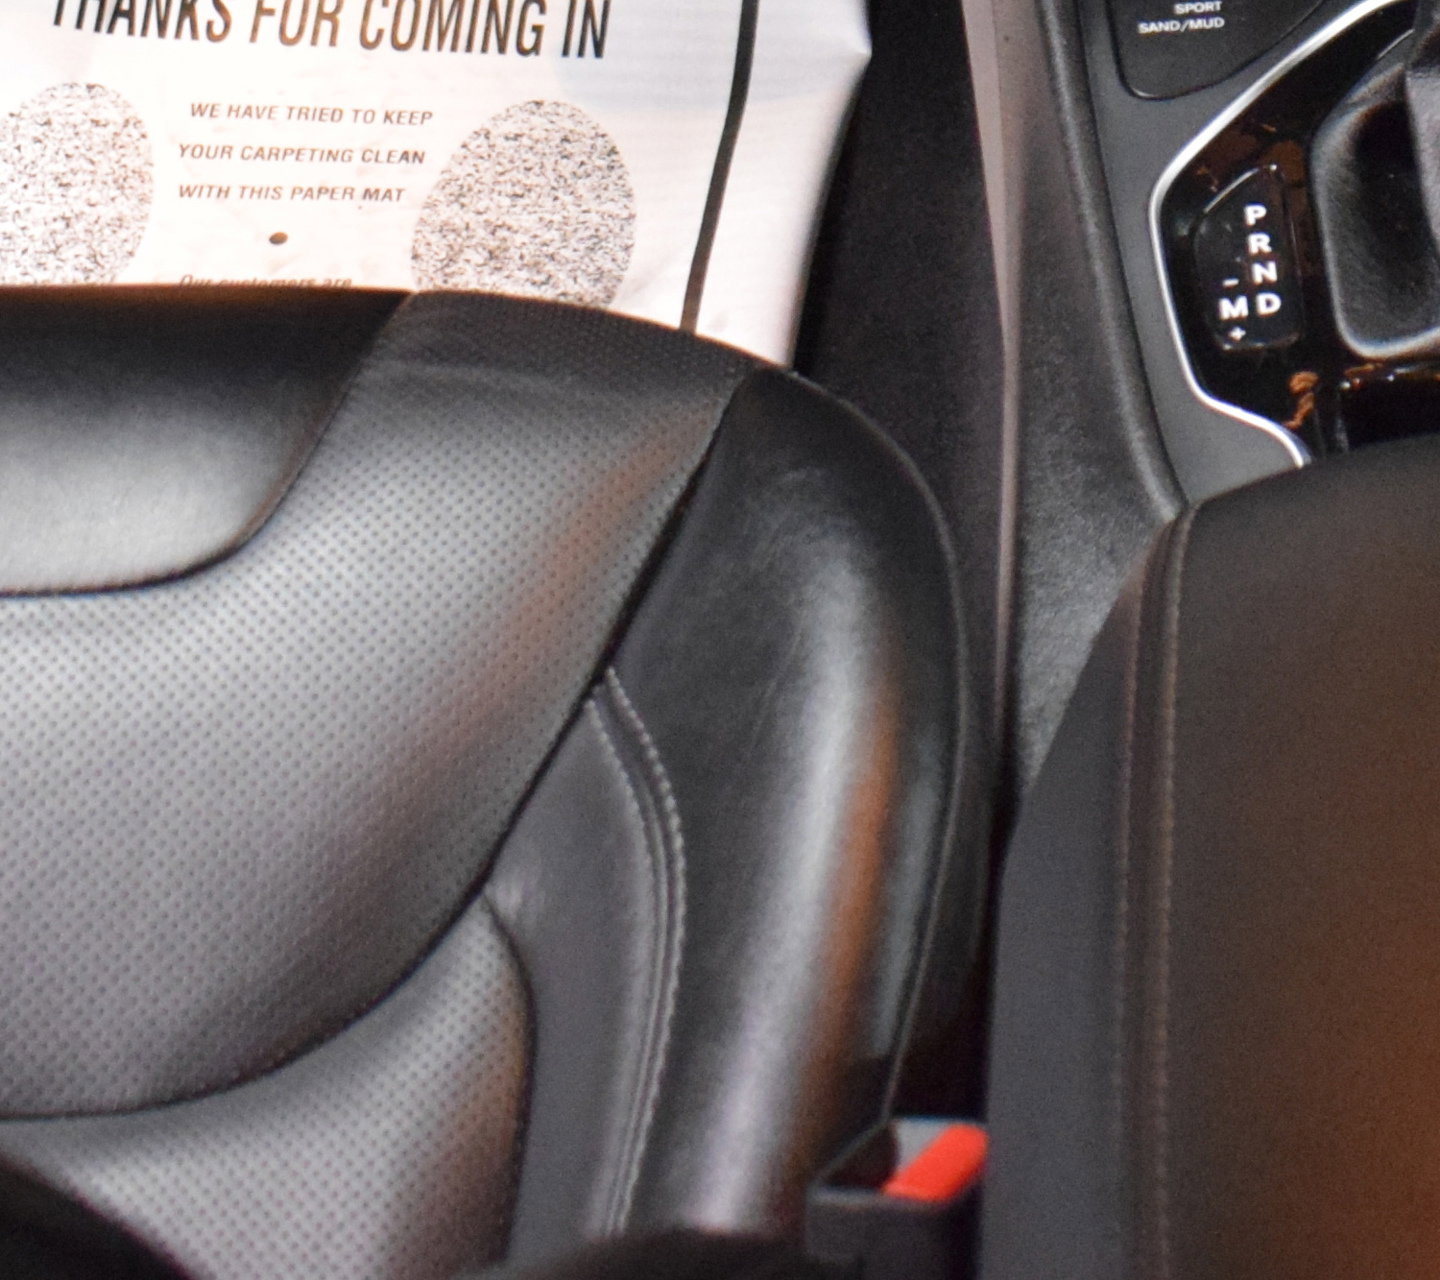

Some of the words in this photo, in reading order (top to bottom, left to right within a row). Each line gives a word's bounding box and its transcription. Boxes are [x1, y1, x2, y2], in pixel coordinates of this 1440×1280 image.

[1173, 0, 1222, 14] SPORT
[1138, 17, 1225, 34] SAND/MUD
[190, 103, 221, 119] WE
[227, 104, 278, 121] HAVE
[286, 106, 344, 123] TRIED
[352, 109, 376, 124] TO
[383, 110, 434, 126] KEEP
[178, 144, 234, 160] YOUR
[240, 146, 354, 163] CARPETING
[361, 149, 426, 165] CLEAN
[178, 185, 230, 199] WITH
[238, 185, 283, 200] THIS
[290, 186, 355, 201] PAPER
[361, 188, 406, 202] MAT
[1244, 204, 1267, 226] P
[1248, 232, 1272, 255] R
[179, 274, 212, 287] Our
[323, 278, 352, 287] are
[1251, 261, 1278, 284] N
[1219, 295, 1249, 320] M
[1256, 292, 1282, 316] D
